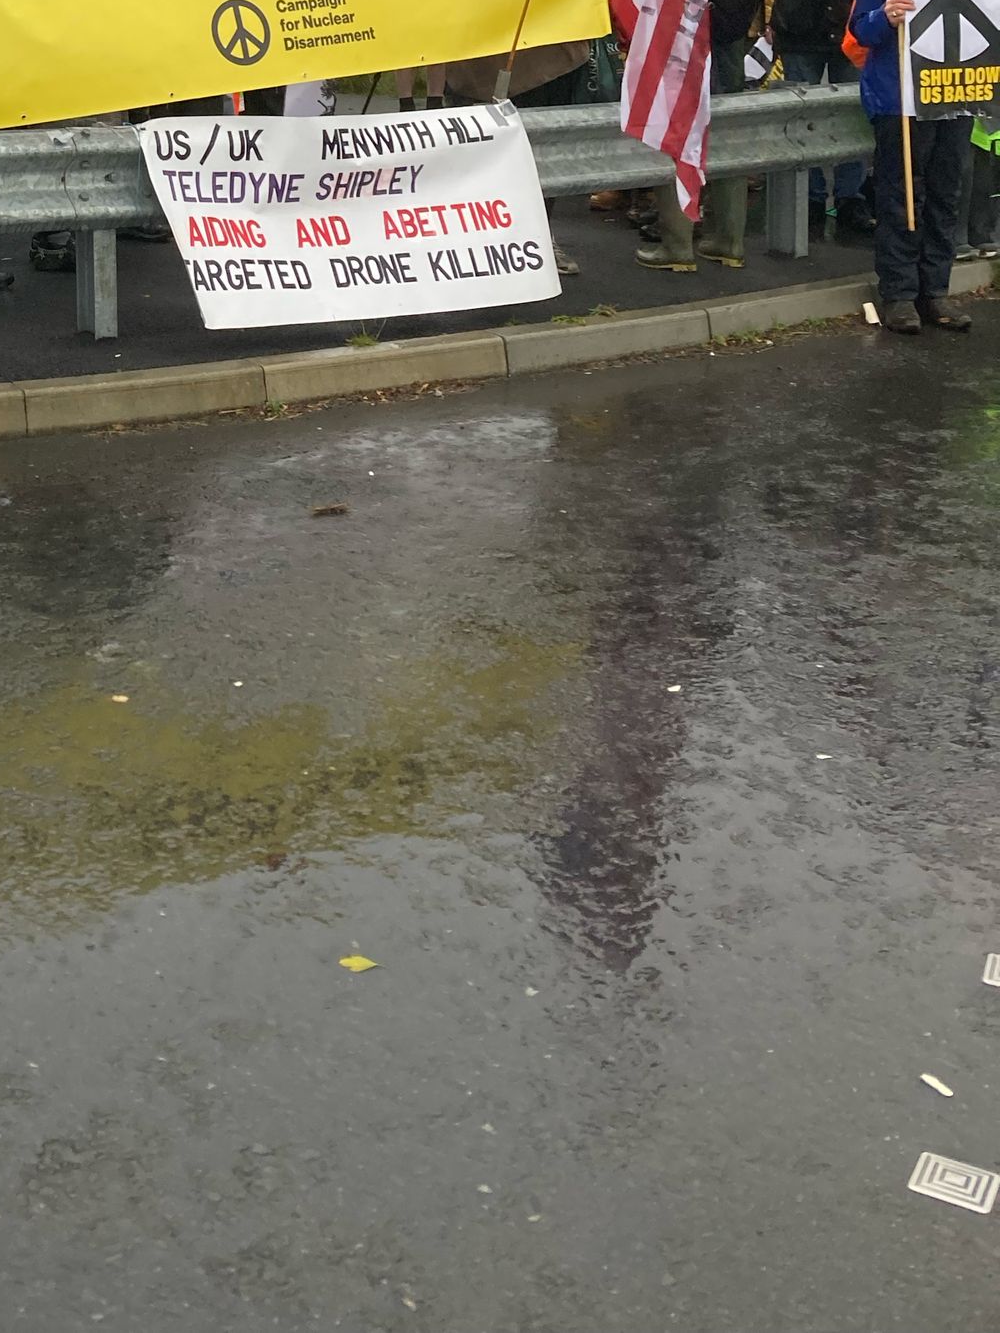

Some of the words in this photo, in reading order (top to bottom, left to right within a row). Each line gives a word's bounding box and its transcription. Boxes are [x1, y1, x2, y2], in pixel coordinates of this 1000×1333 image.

[280, 19, 300, 32] for
[302, 12, 355, 29] Nuclear
[284, 27, 375, 51] Disarmament
[920, 68, 963, 86] SHUT
[965, 67, 1000, 84] DOW
[920, 86, 942, 104] US
[944, 84, 993, 103] BASES
[321, 120, 435, 160] MENWITH
[438, 115, 494, 145] HILL
[162, 170, 305, 204] TELEDYNE
[315, 164, 424, 201] SHIPLEY
[188, 216, 267, 248] AIDING
[296, 215, 351, 248] AND
[382, 199, 512, 240] ABETTING
[329, 252, 417, 288] DRONE
[427, 240, 544, 282] KILLINGS
